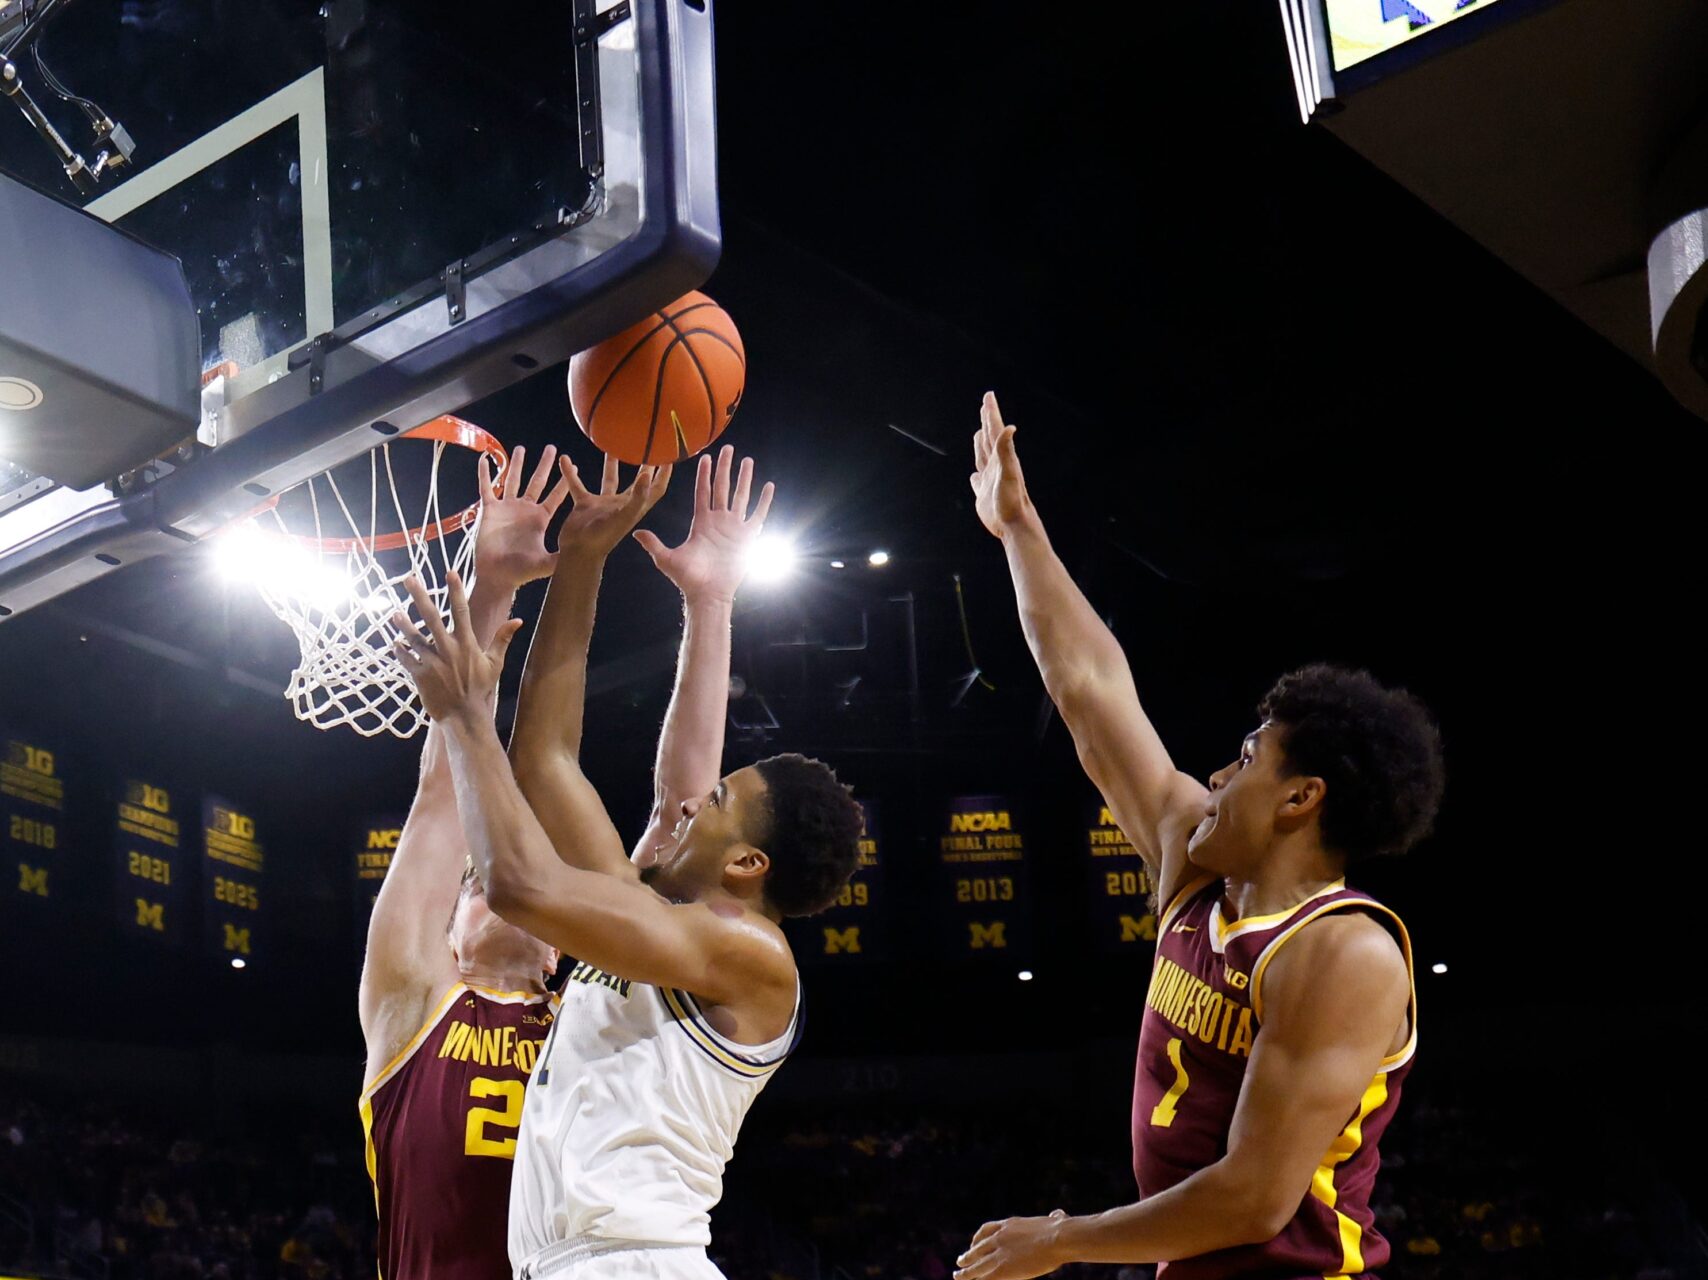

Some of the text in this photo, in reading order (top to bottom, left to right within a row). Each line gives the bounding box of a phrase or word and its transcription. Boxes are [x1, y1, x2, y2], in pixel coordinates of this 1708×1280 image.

[951, 811, 1012, 832] NCAA
[19, 863, 49, 896] M
[129, 851, 170, 885] 2021
[956, 877, 1014, 903] 2013
[136, 897, 165, 932] M
[1119, 914, 1158, 942] M
[223, 921, 251, 954] M
[823, 928, 863, 954] M
[969, 920, 1007, 949] M
[1150, 1037, 1190, 1128] 1
[464, 1076, 525, 1160] 2
